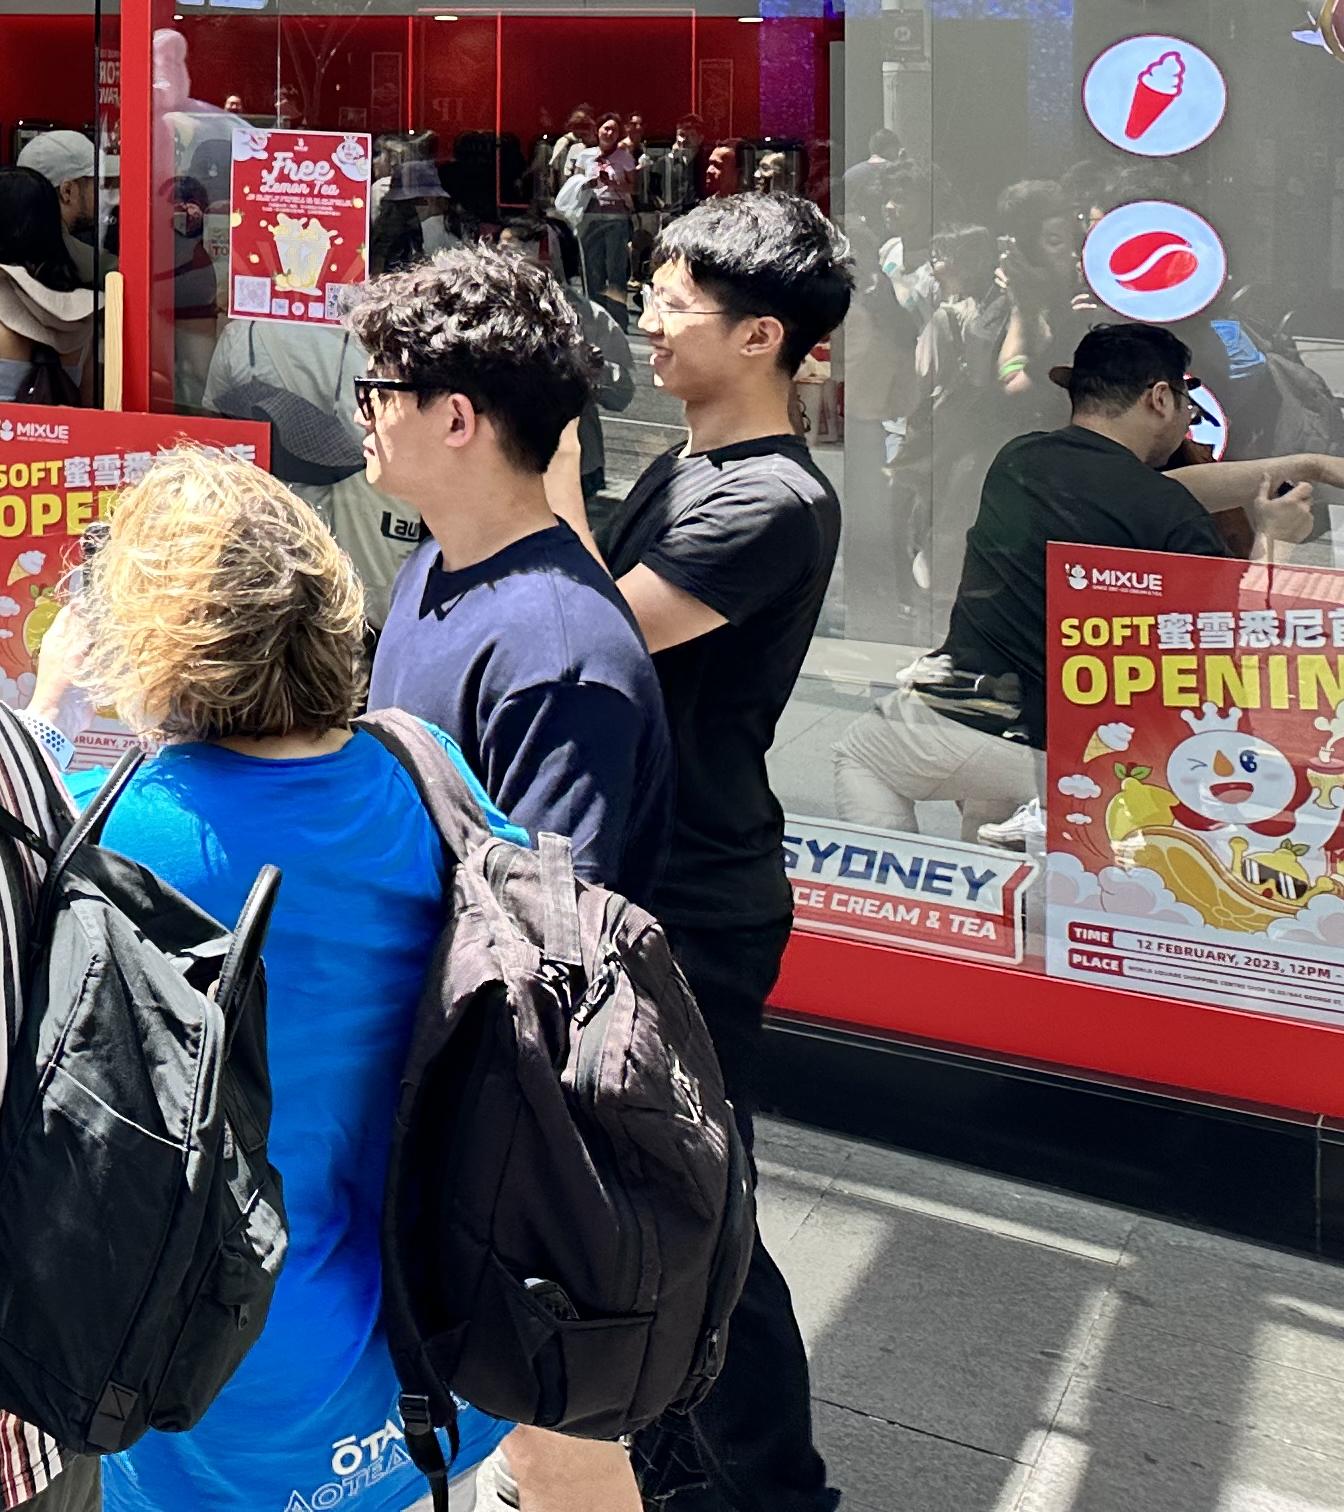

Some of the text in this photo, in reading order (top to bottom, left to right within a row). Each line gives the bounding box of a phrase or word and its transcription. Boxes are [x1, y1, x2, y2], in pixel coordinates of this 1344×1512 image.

[260, 151, 336, 184] Free
[259, 177, 340, 196] Lemon Tea
[16, 421, 69, 441] MIXUE
[1092, 567, 1163, 592] MIXUE
[1060, 615, 1155, 647] SOFT
[783, 834, 998, 902] SYDNEY
[794, 886, 997, 941] CE CREAM & TEA
[1072, 953, 1121, 972] PLACE
[1073, 926, 1332, 979] TIME 12 FEBRUARY, 2023, 12PM
[331, 1418, 405, 1476] ŌTA
